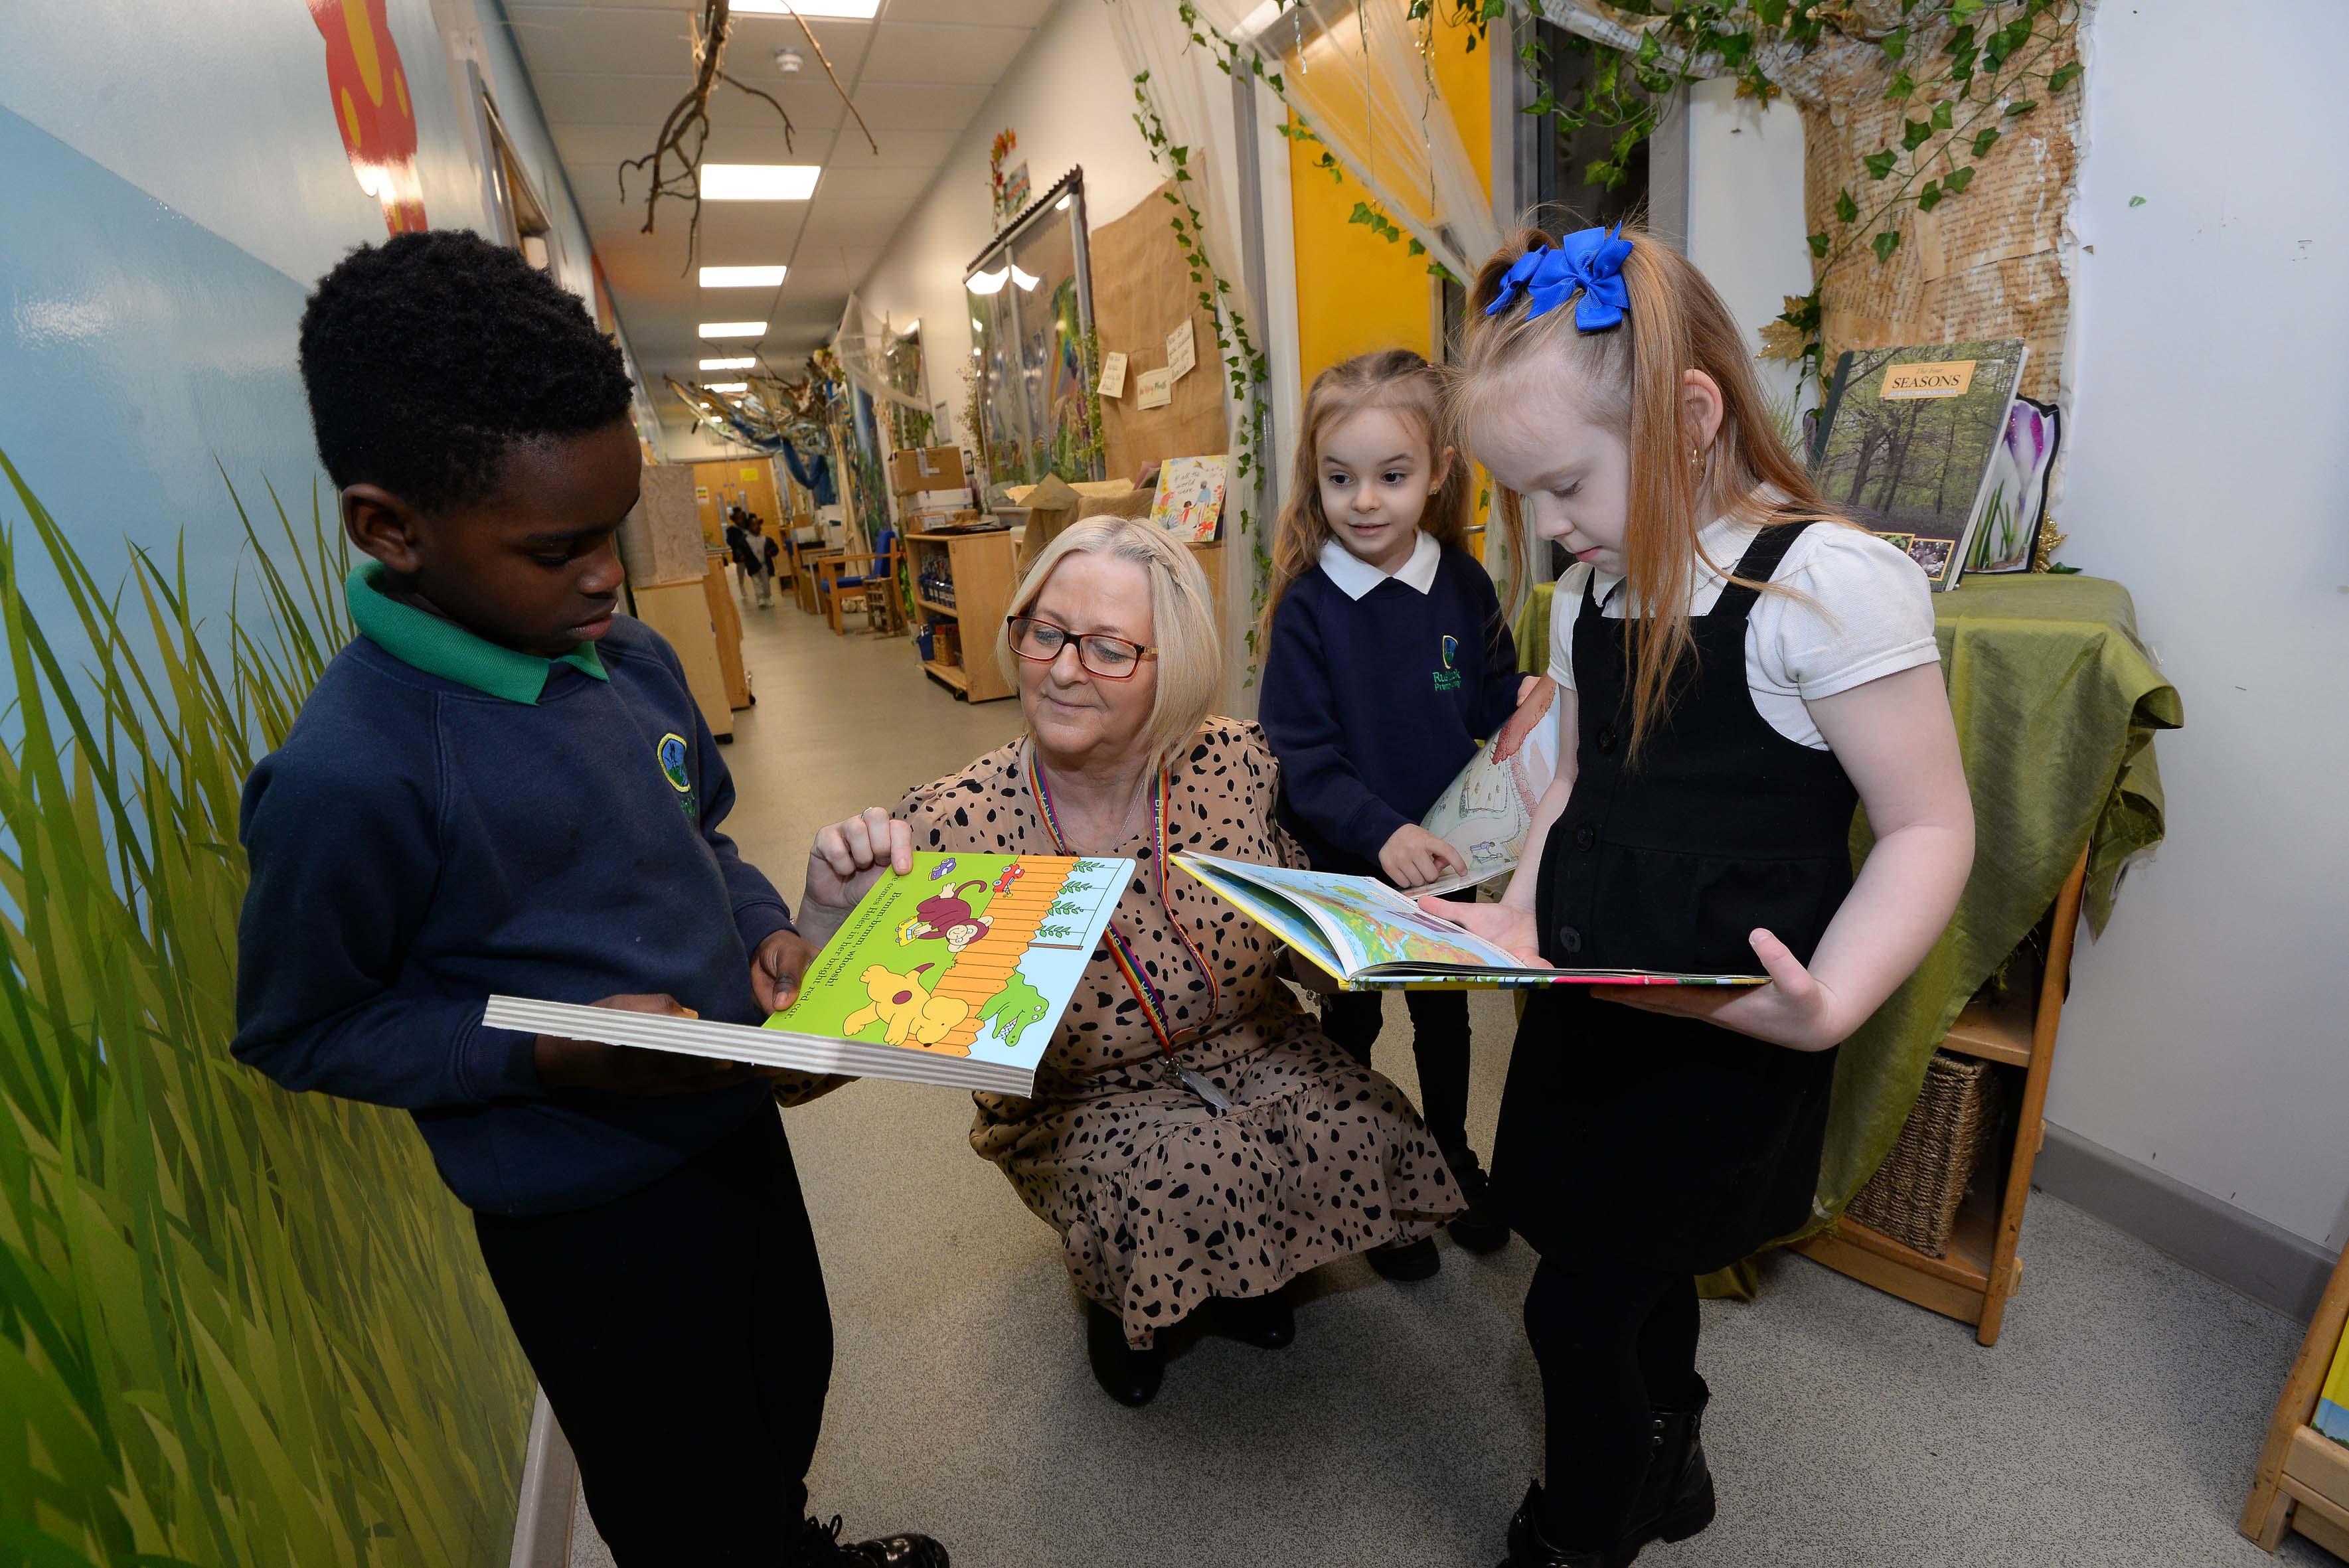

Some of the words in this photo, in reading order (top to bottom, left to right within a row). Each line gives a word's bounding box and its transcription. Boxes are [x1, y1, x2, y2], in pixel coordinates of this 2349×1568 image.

[1892, 374, 1961, 389] SEASONS
[1176, 478, 1196, 489] world
[1039, 791, 1052, 818] RPA
[1156, 835, 1165, 862] RPA
[872, 883, 894, 905] comes
[852, 892, 902, 948] Brmm-brmm,
[854, 907, 878, 929] Helen
[847, 931, 859, 940] in
[835, 941, 851, 956] her
[813, 957, 840, 984] bright
[825, 951, 856, 986] whoosh!
[800, 986, 815, 1001] red
[1137, 981, 1156, 1008] RPA
[784, 1003, 801, 1020] car.
